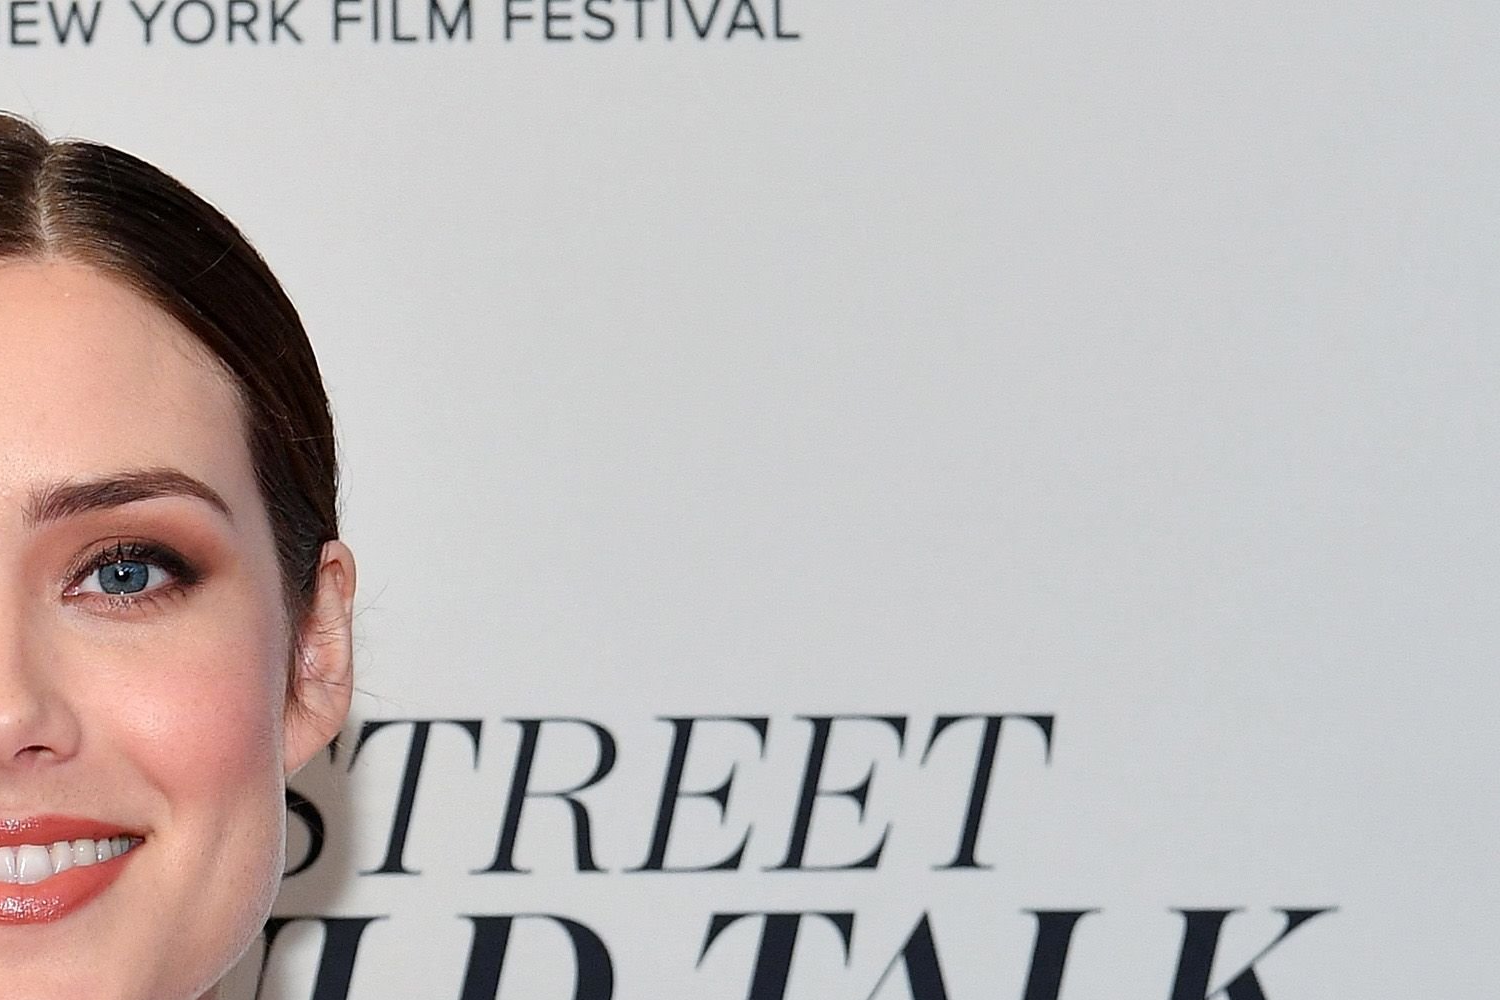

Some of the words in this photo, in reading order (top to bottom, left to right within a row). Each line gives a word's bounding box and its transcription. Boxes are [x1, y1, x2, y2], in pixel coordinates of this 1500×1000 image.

[128, 0, 304, 46] YORK
[331, 0, 475, 43] FILM
[502, 0, 802, 43] FESTIVAL
